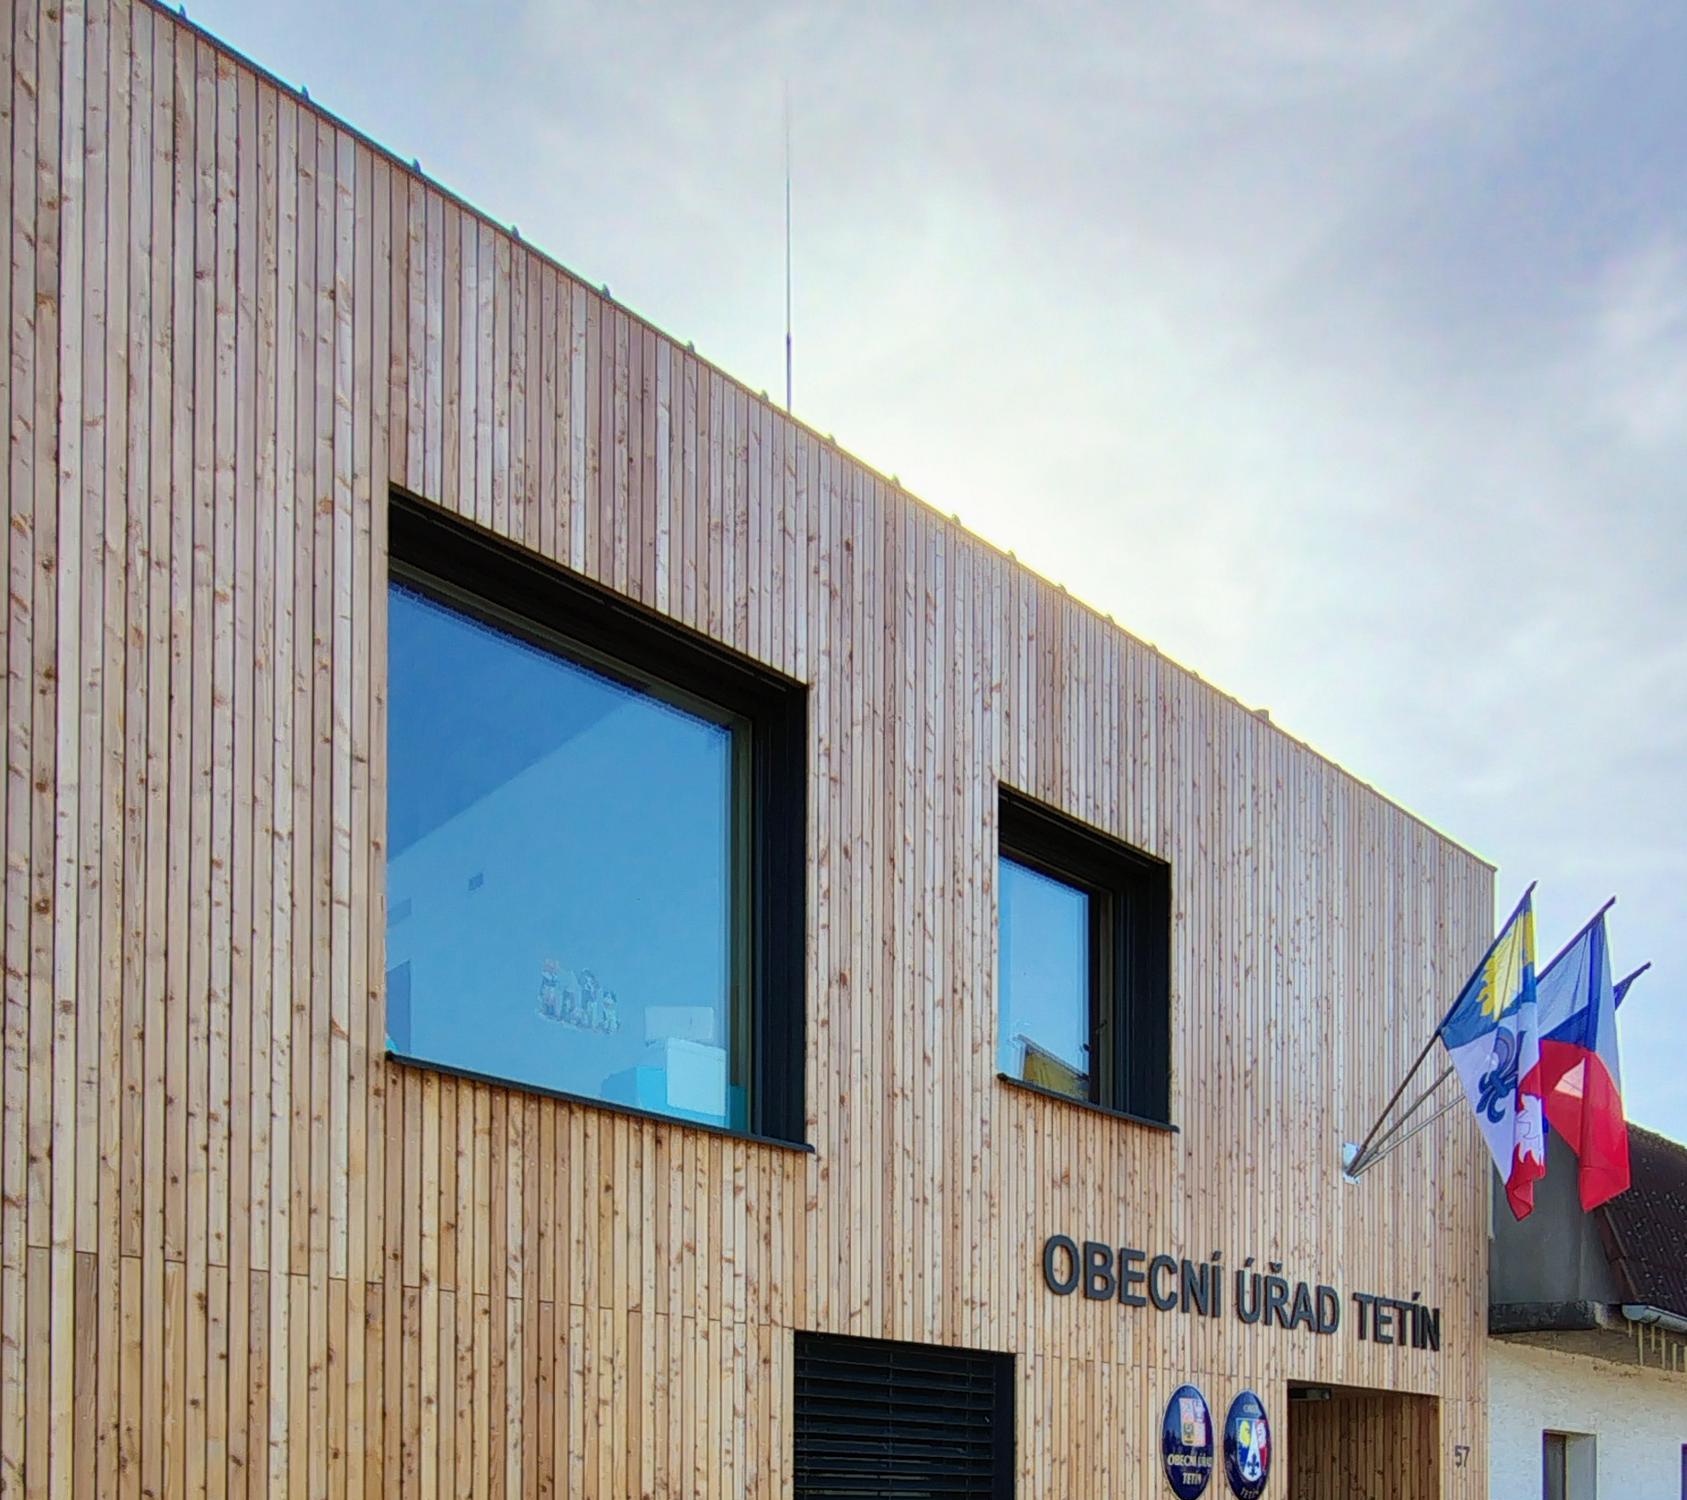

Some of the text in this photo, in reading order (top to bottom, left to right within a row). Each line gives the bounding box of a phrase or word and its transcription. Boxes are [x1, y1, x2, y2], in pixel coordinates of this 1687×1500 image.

[1043, 1234, 1440, 1352] OBECNÍ ÚŘAD TETÍN
[1454, 1445, 1470, 1468] 57
